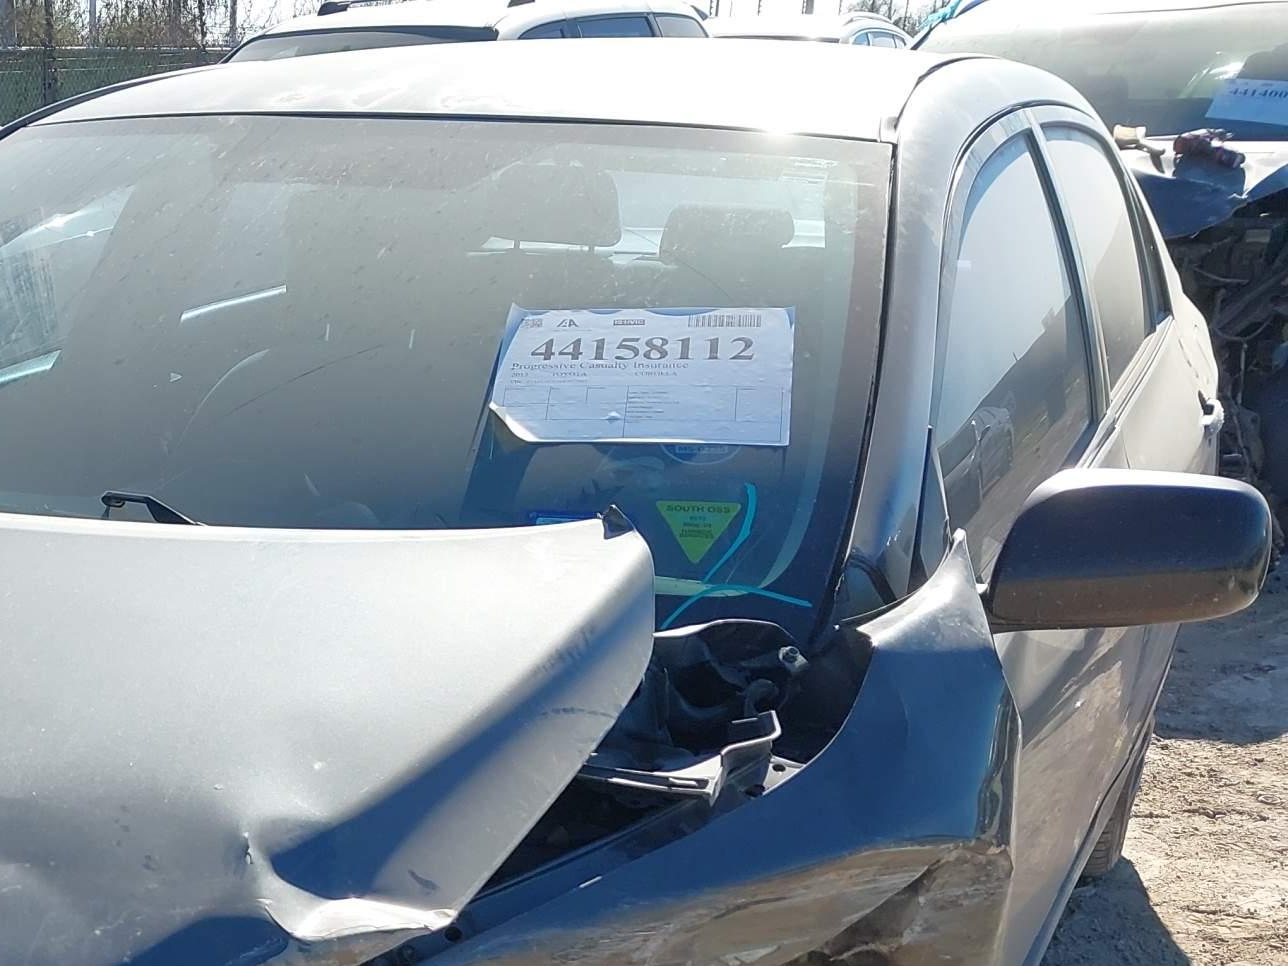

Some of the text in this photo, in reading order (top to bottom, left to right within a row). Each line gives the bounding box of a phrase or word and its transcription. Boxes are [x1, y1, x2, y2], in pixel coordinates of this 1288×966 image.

[530, 336, 755, 361] 44158112
[511, 361, 689, 371] Progressive Casualty Insurance
[666, 505, 704, 513] SOUTH
